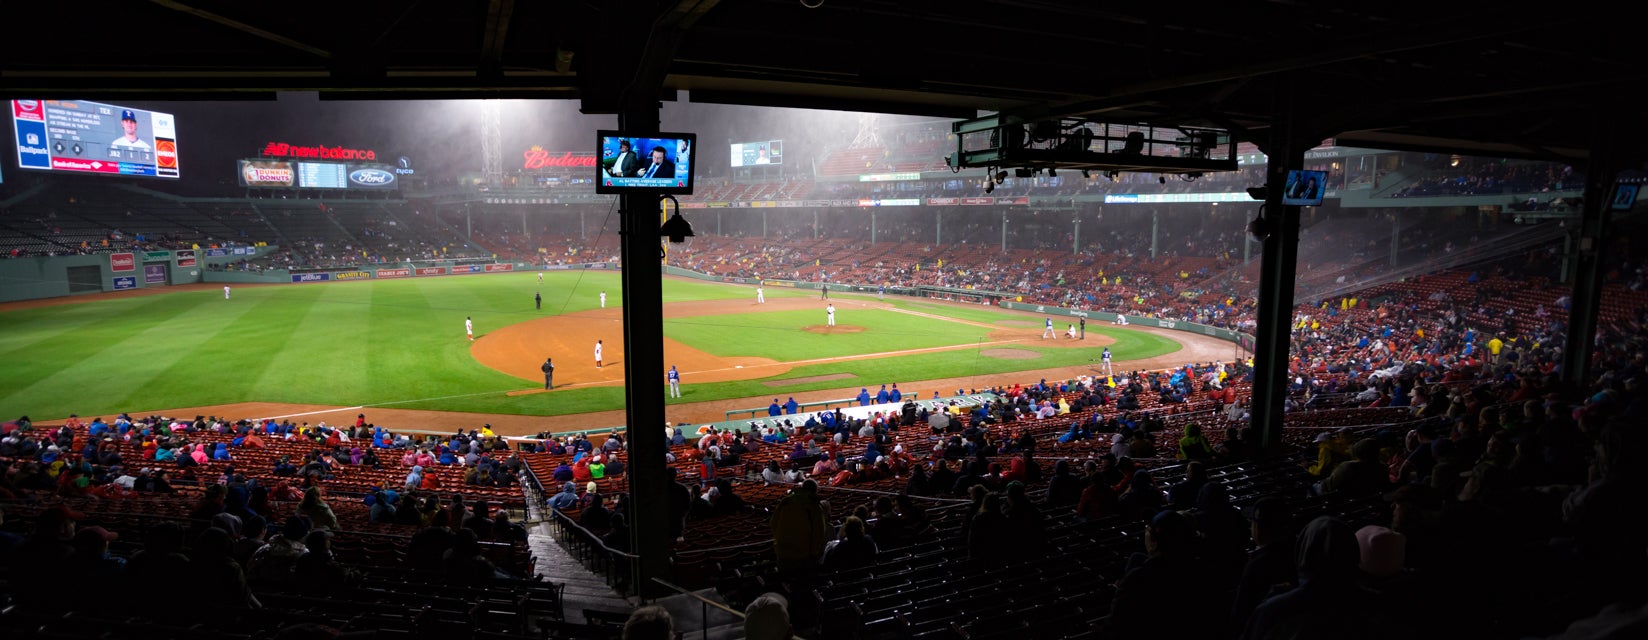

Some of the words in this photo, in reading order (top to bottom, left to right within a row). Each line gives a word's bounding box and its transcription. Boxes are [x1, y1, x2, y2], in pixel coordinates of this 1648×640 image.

[320, 145, 376, 160] balance
[259, 174, 290, 182] DONUTS
[358, 171, 386, 184] Ford
[301, 273, 322, 282] jetBlue
[359, 271, 371, 279] CITY
